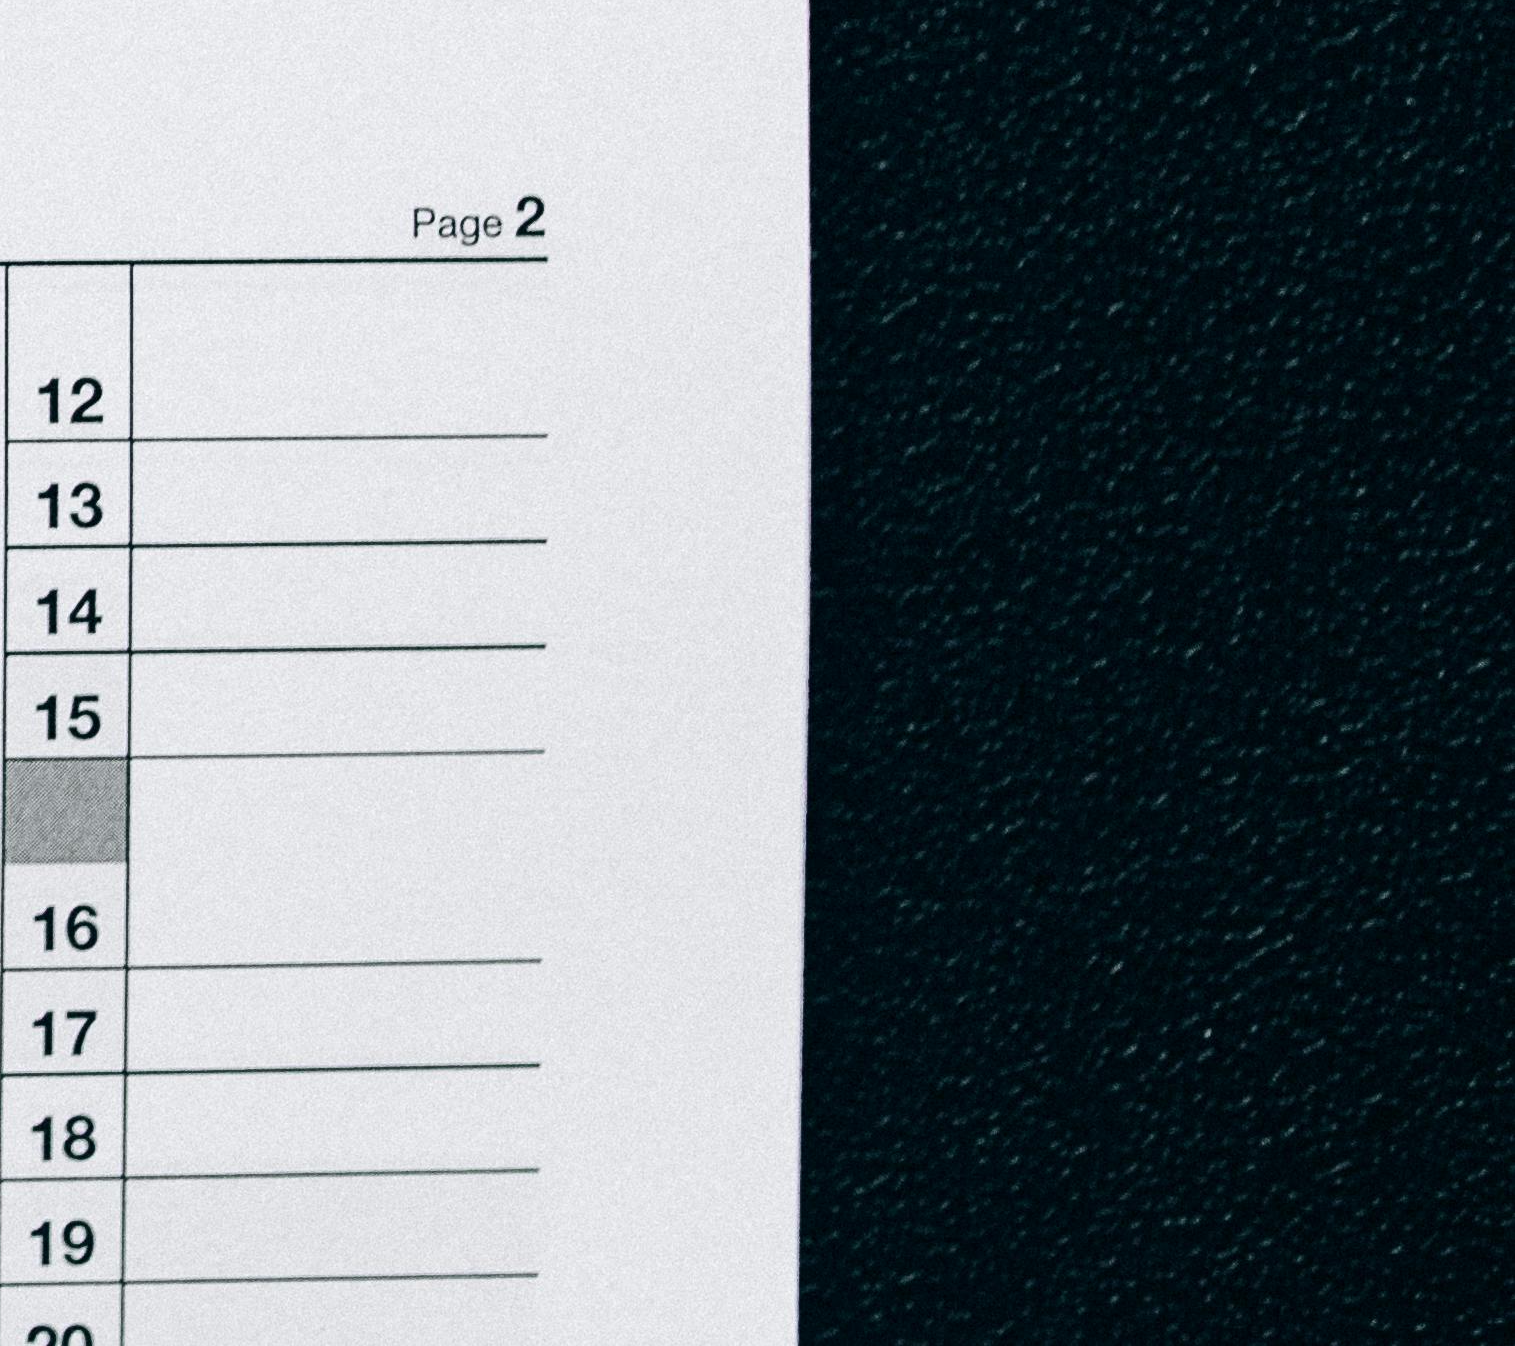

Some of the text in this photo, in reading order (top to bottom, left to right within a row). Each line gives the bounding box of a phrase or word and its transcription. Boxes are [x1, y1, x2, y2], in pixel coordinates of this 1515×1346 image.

[410, 194, 547, 248] Page 2
[37, 376, 105, 425] 12
[36, 480, 105, 530] 13
[35, 587, 104, 636] 14
[34, 693, 102, 742] 15
[32, 903, 100, 953] 16
[31, 1008, 99, 1058] 17
[30, 1113, 98, 1163] 18
[29, 1218, 96, 1268] 19
